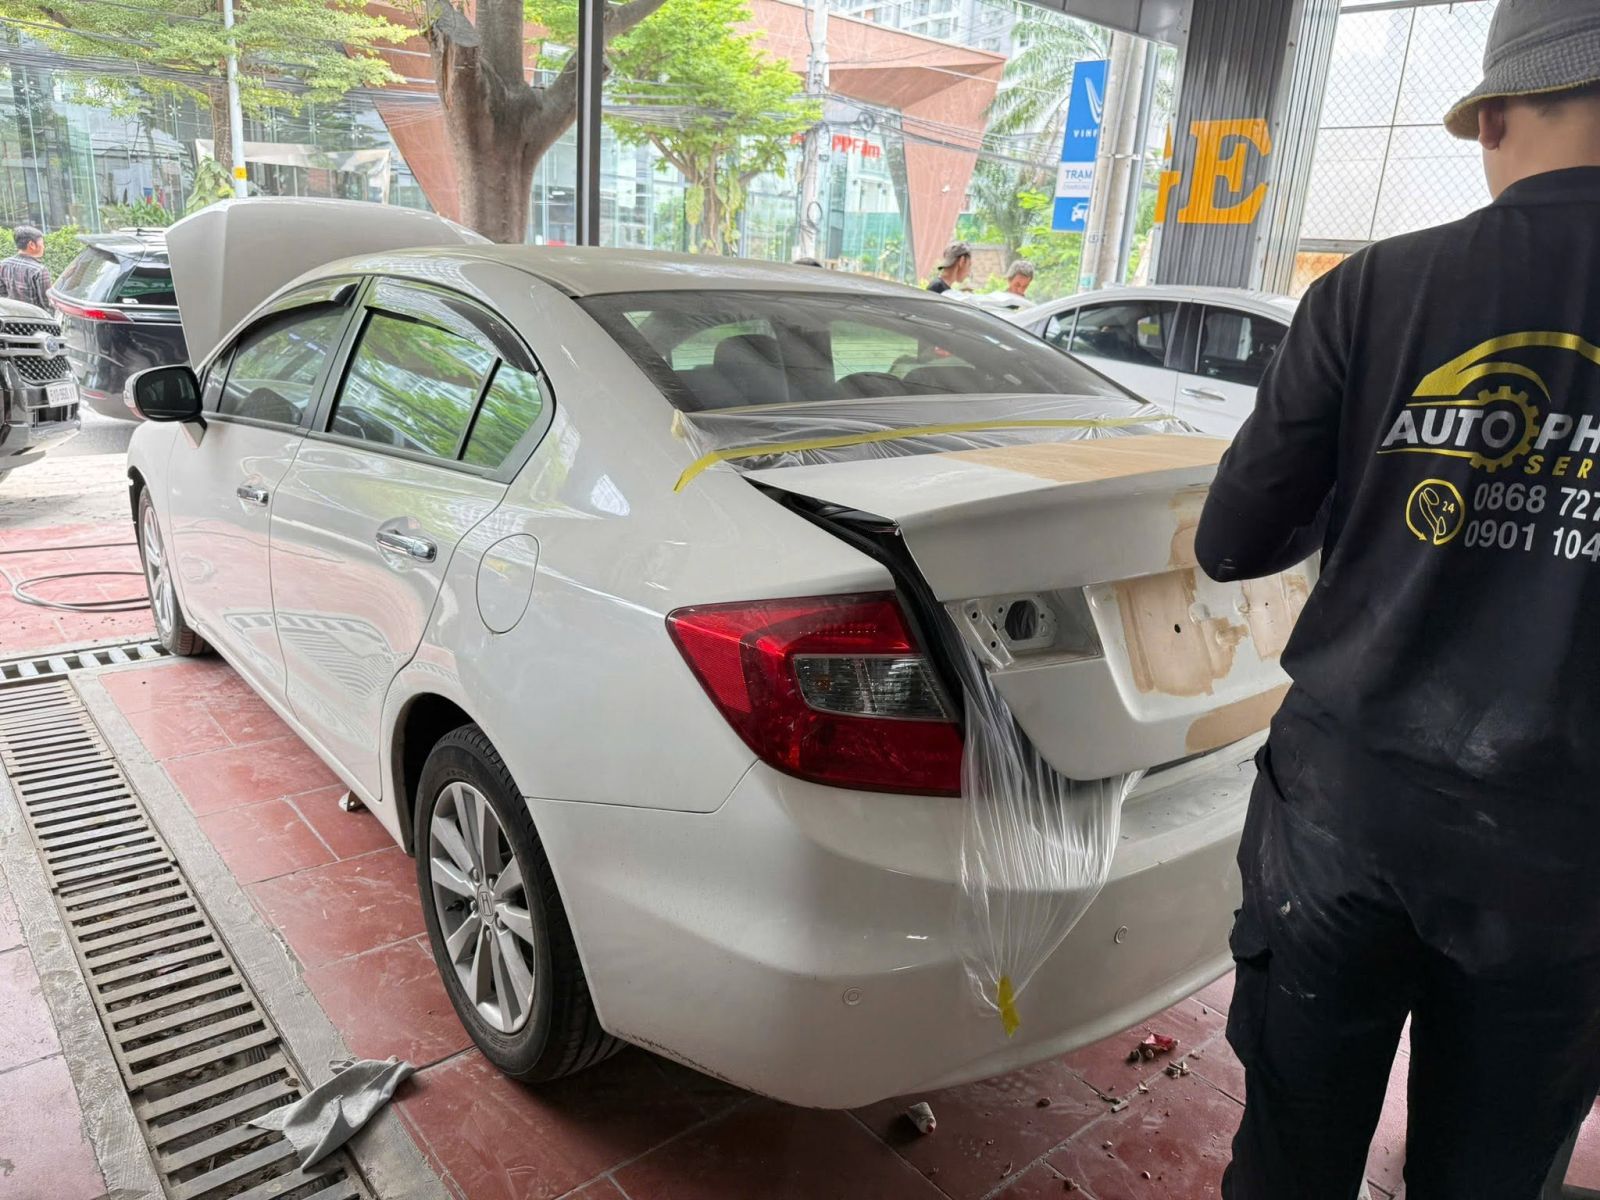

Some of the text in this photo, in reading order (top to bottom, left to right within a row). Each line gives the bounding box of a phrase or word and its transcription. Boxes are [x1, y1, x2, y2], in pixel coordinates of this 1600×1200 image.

[1381, 408, 1516, 449] AUTO
[1524, 454, 1594, 479] SER
[1473, 481, 1547, 514] 0868
[1464, 519, 1600, 562] 0901 104
